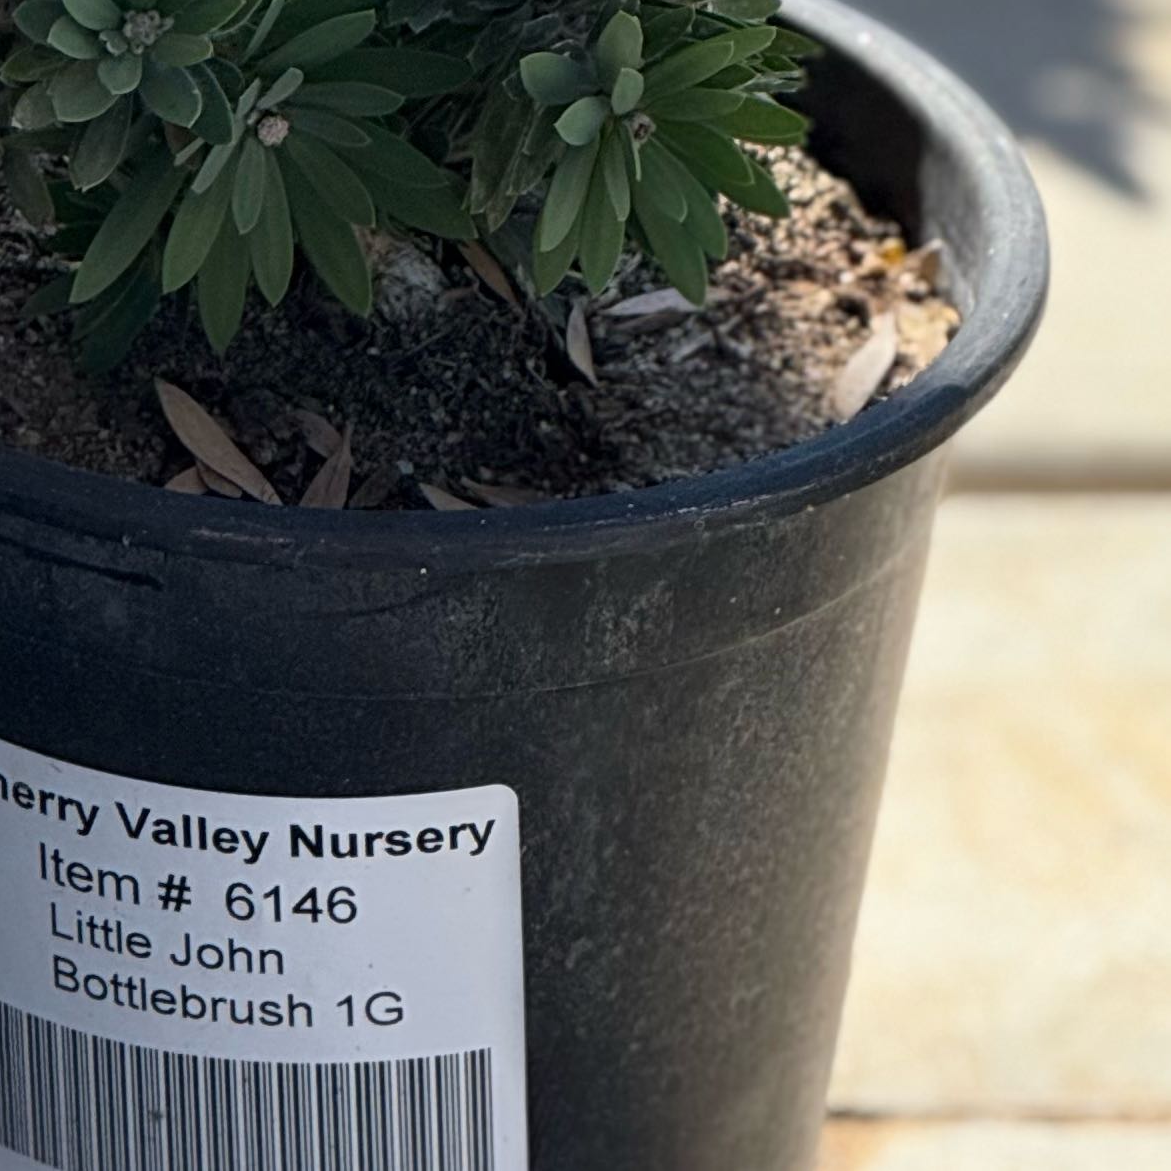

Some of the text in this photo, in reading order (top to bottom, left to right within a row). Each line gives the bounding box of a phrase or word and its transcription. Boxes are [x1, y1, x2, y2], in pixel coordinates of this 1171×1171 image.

[114, 801, 270, 865] Valley
[289, 819, 496, 859] Nursery
[38, 841, 358, 925] Item # 6146
[50, 901, 284, 976] Little John
[52, 953, 404, 1028] Bottlebrush 1G
